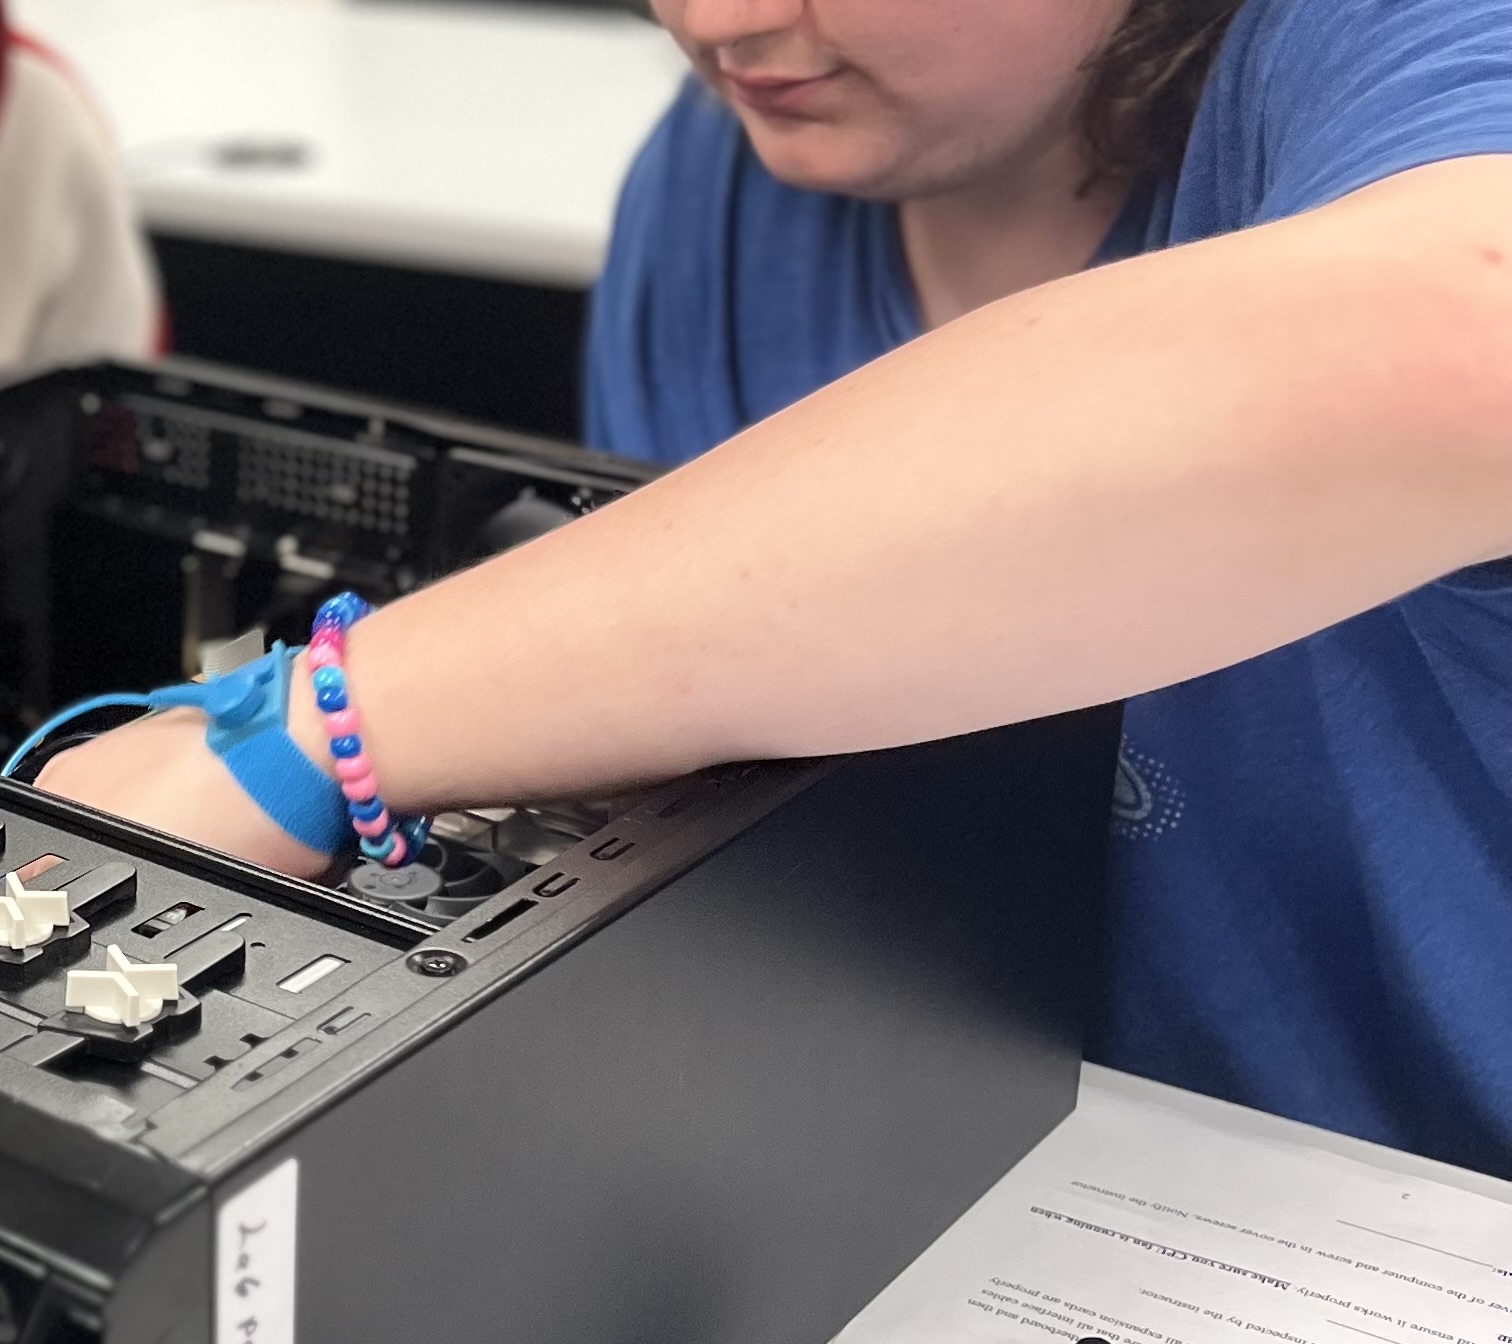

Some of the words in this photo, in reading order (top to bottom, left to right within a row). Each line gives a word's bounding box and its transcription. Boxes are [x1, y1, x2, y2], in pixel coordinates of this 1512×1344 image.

[1202, 1308, 1224, 1320] the
[1352, 1304, 1393, 1322] works
[1408, 1322, 1454, 1340] ensure
